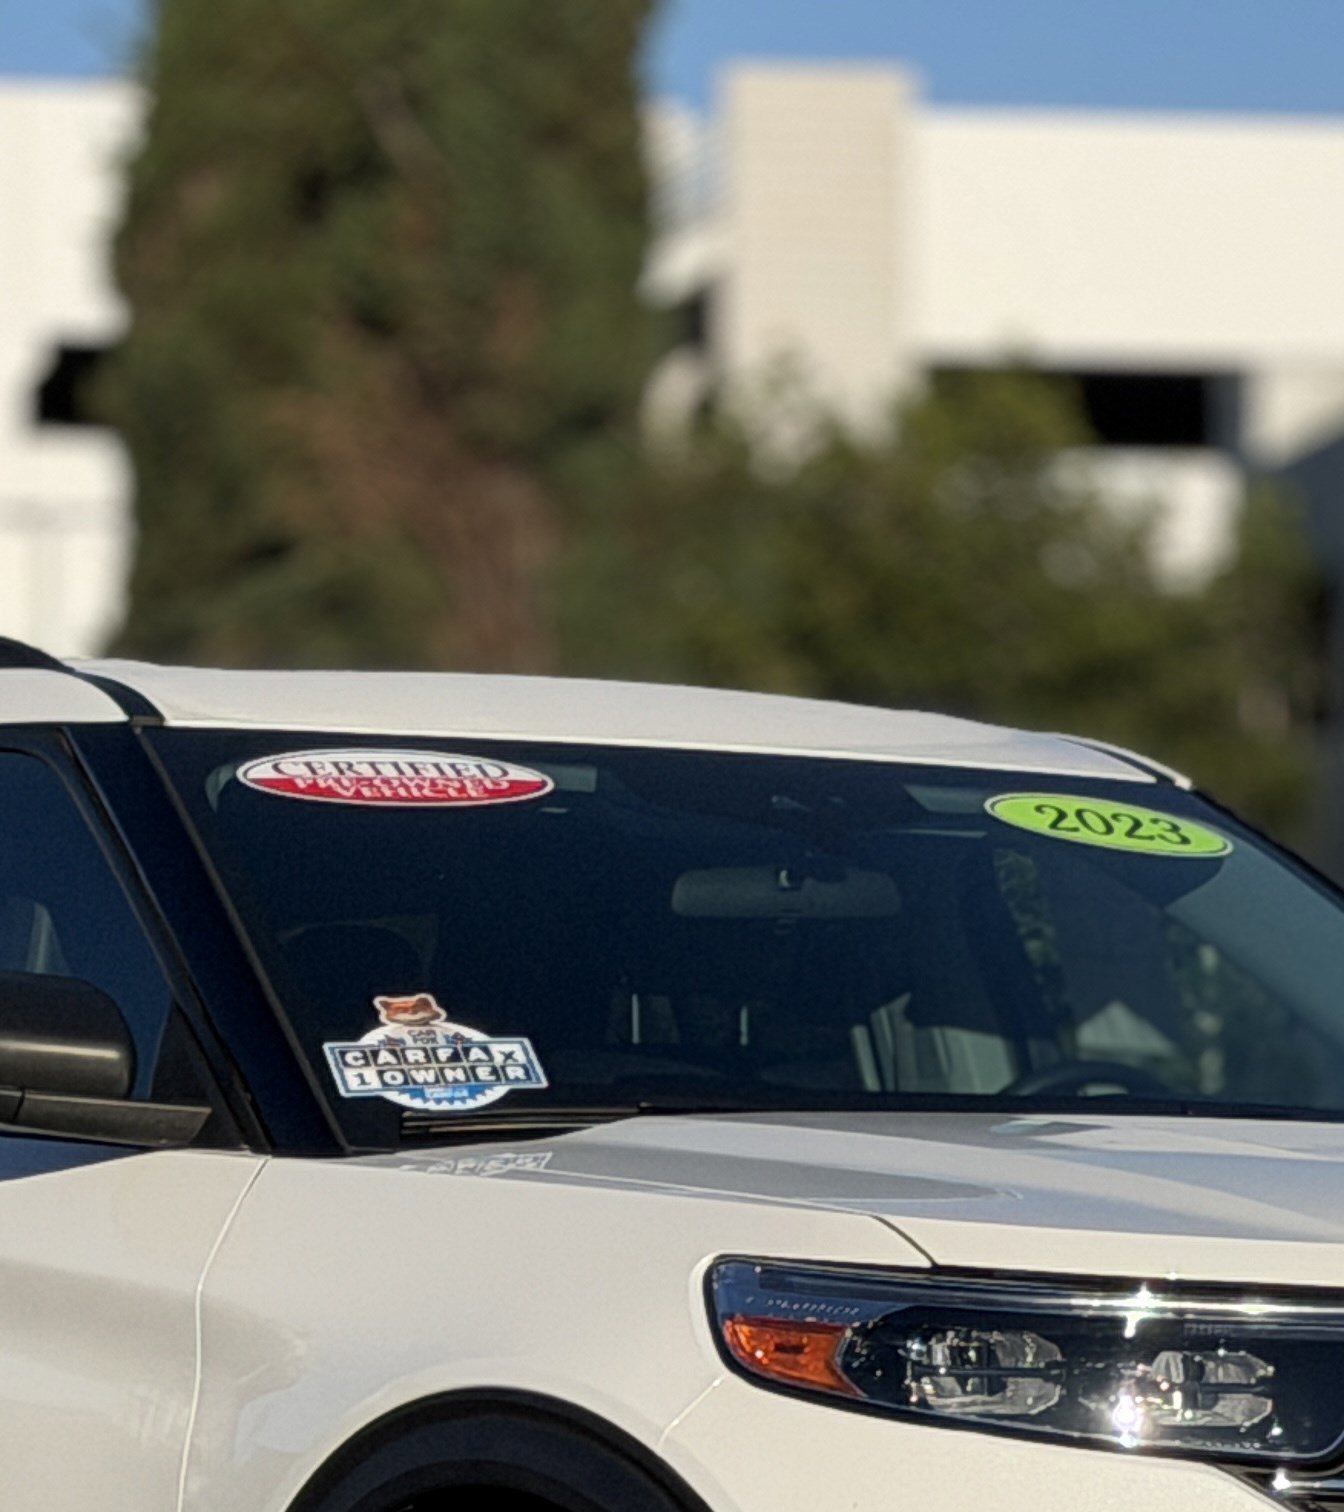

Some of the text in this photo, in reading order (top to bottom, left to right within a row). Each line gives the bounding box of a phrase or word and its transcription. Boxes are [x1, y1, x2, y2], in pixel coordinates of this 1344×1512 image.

[270, 760, 510, 779] CERTIFIED
[1033, 803, 1191, 846] 2023
[344, 1046, 520, 1066] CARFAX
[353, 1066, 527, 1087] 1 OWNER
